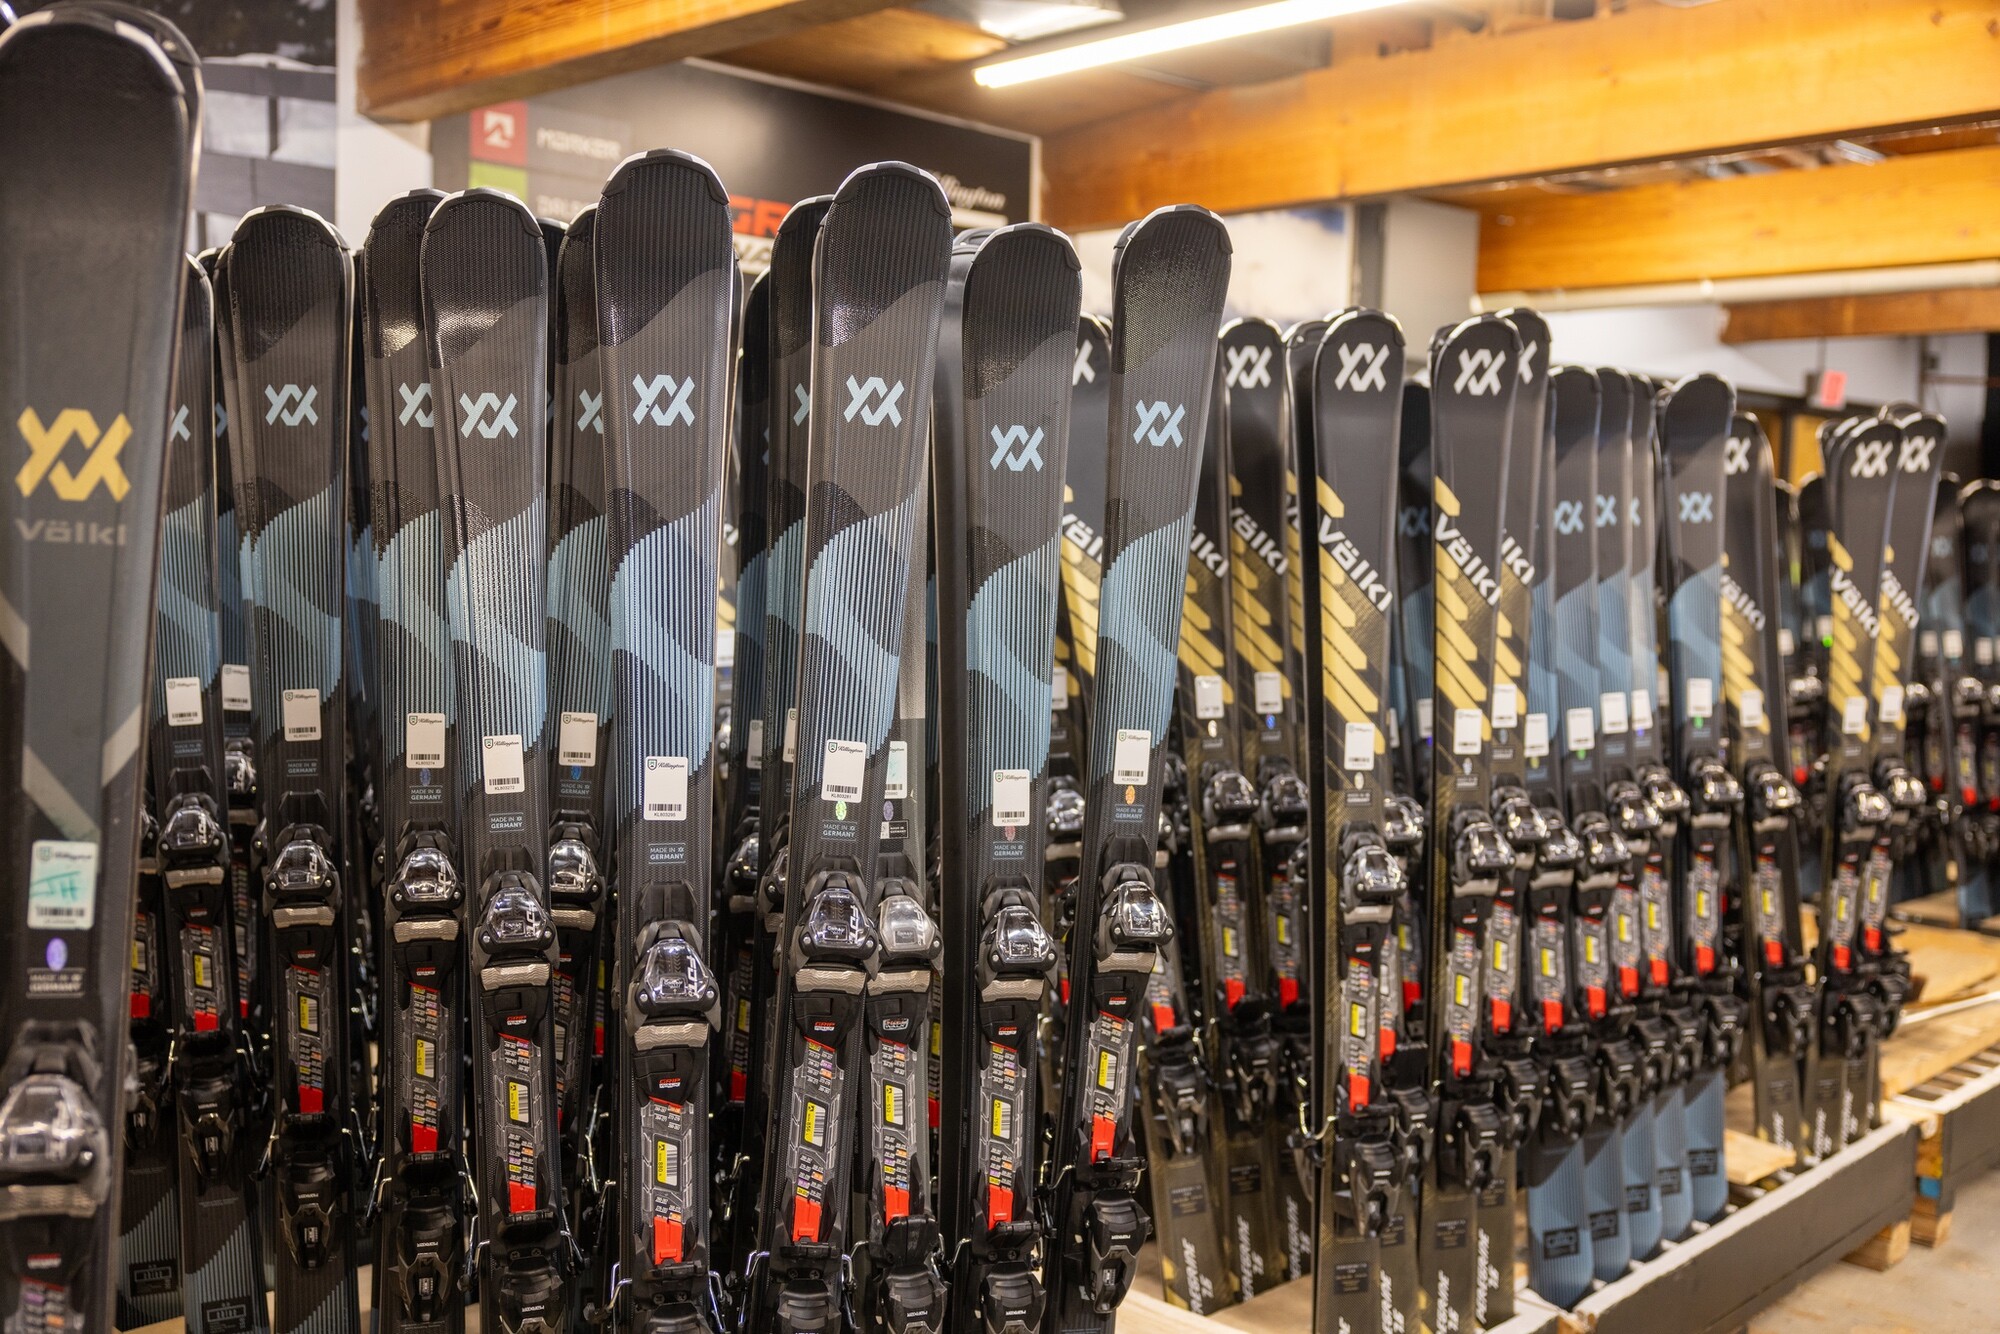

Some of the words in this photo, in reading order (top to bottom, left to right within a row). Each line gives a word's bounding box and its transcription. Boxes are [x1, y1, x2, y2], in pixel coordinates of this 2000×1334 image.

[536, 127, 622, 161] MARKER
[15, 518, 127, 546] Völkl
[1318, 514, 1394, 613] Völkl
[1435, 513, 1503, 606] Völkl
[418, 717, 442, 725] Killington
[571, 716, 595, 724] Killington
[493, 740, 520, 748] Killington
[837, 745, 863, 754] Killington
[658, 762, 685, 771] Killington
[1004, 774, 1027, 782] Killington
[560, 787, 590, 796] GERMANY
[1115, 812, 1142, 820] GERMANY
[491, 821, 523, 829] GERMANY
[823, 823, 841, 831] MADE
[822, 829, 856, 839] GERMANY
